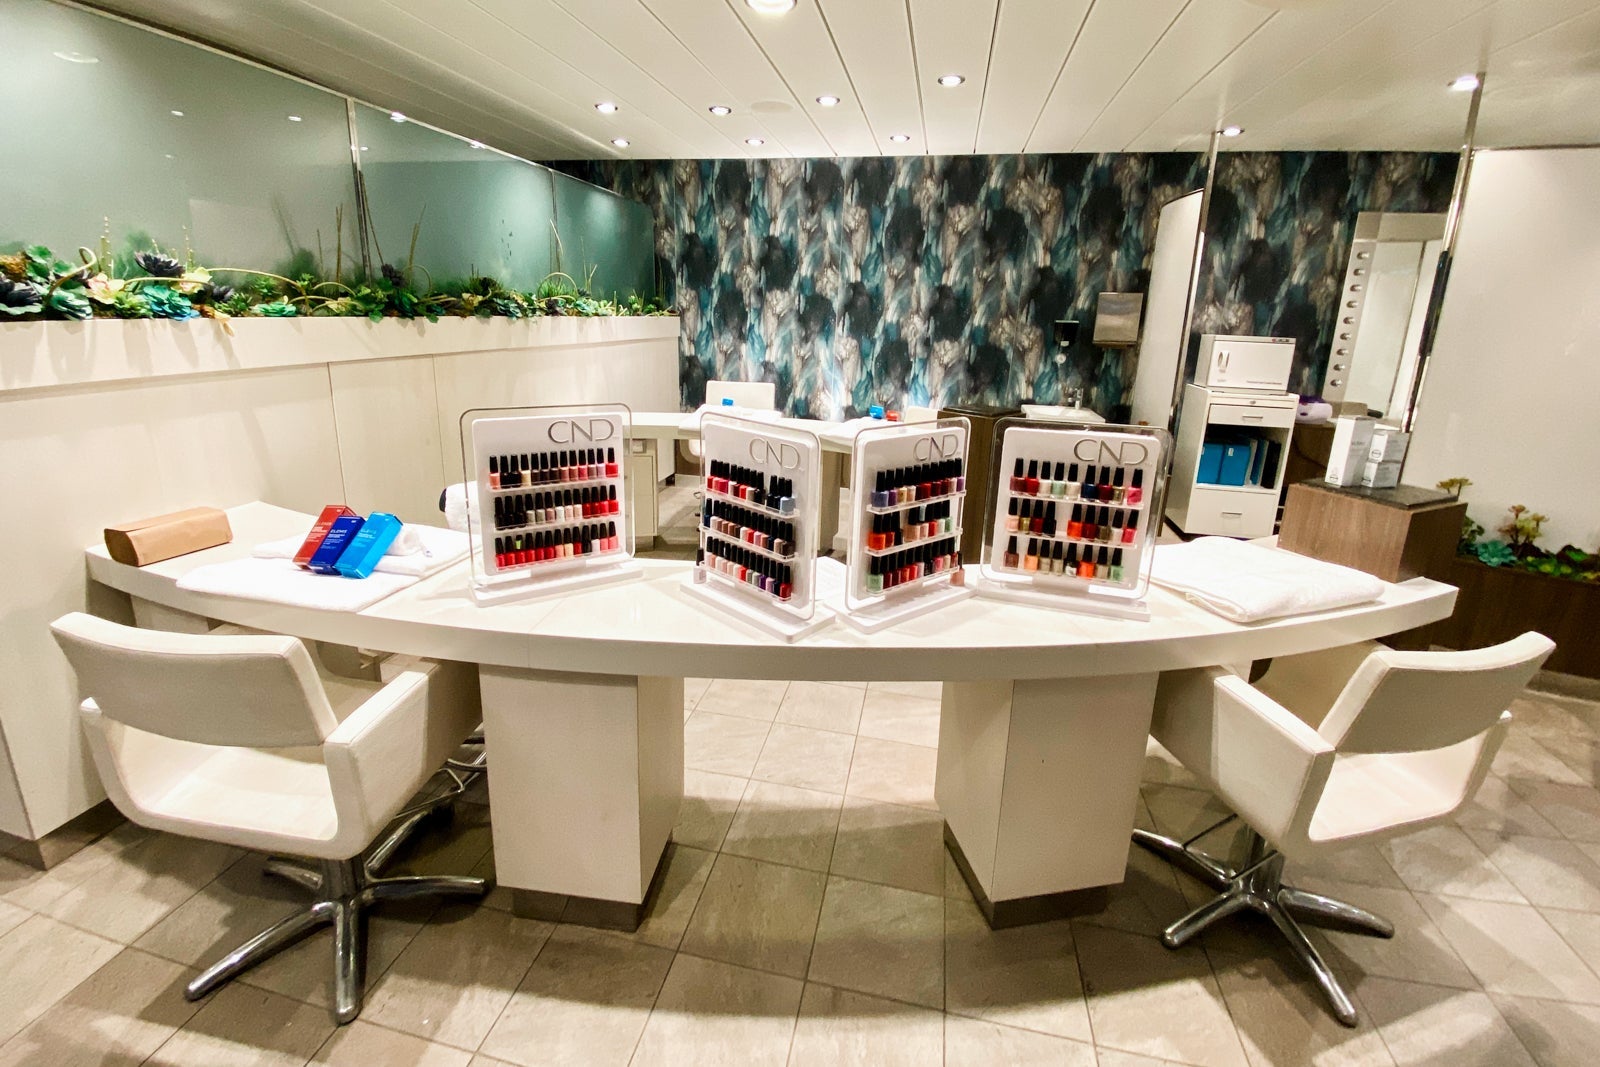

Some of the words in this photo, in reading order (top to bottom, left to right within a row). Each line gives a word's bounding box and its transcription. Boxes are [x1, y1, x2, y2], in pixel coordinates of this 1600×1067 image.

[547, 418, 614, 444] CND
[749, 438, 801, 469] CND
[913, 434, 959, 462] CND
[1073, 438, 1149, 466] CND
